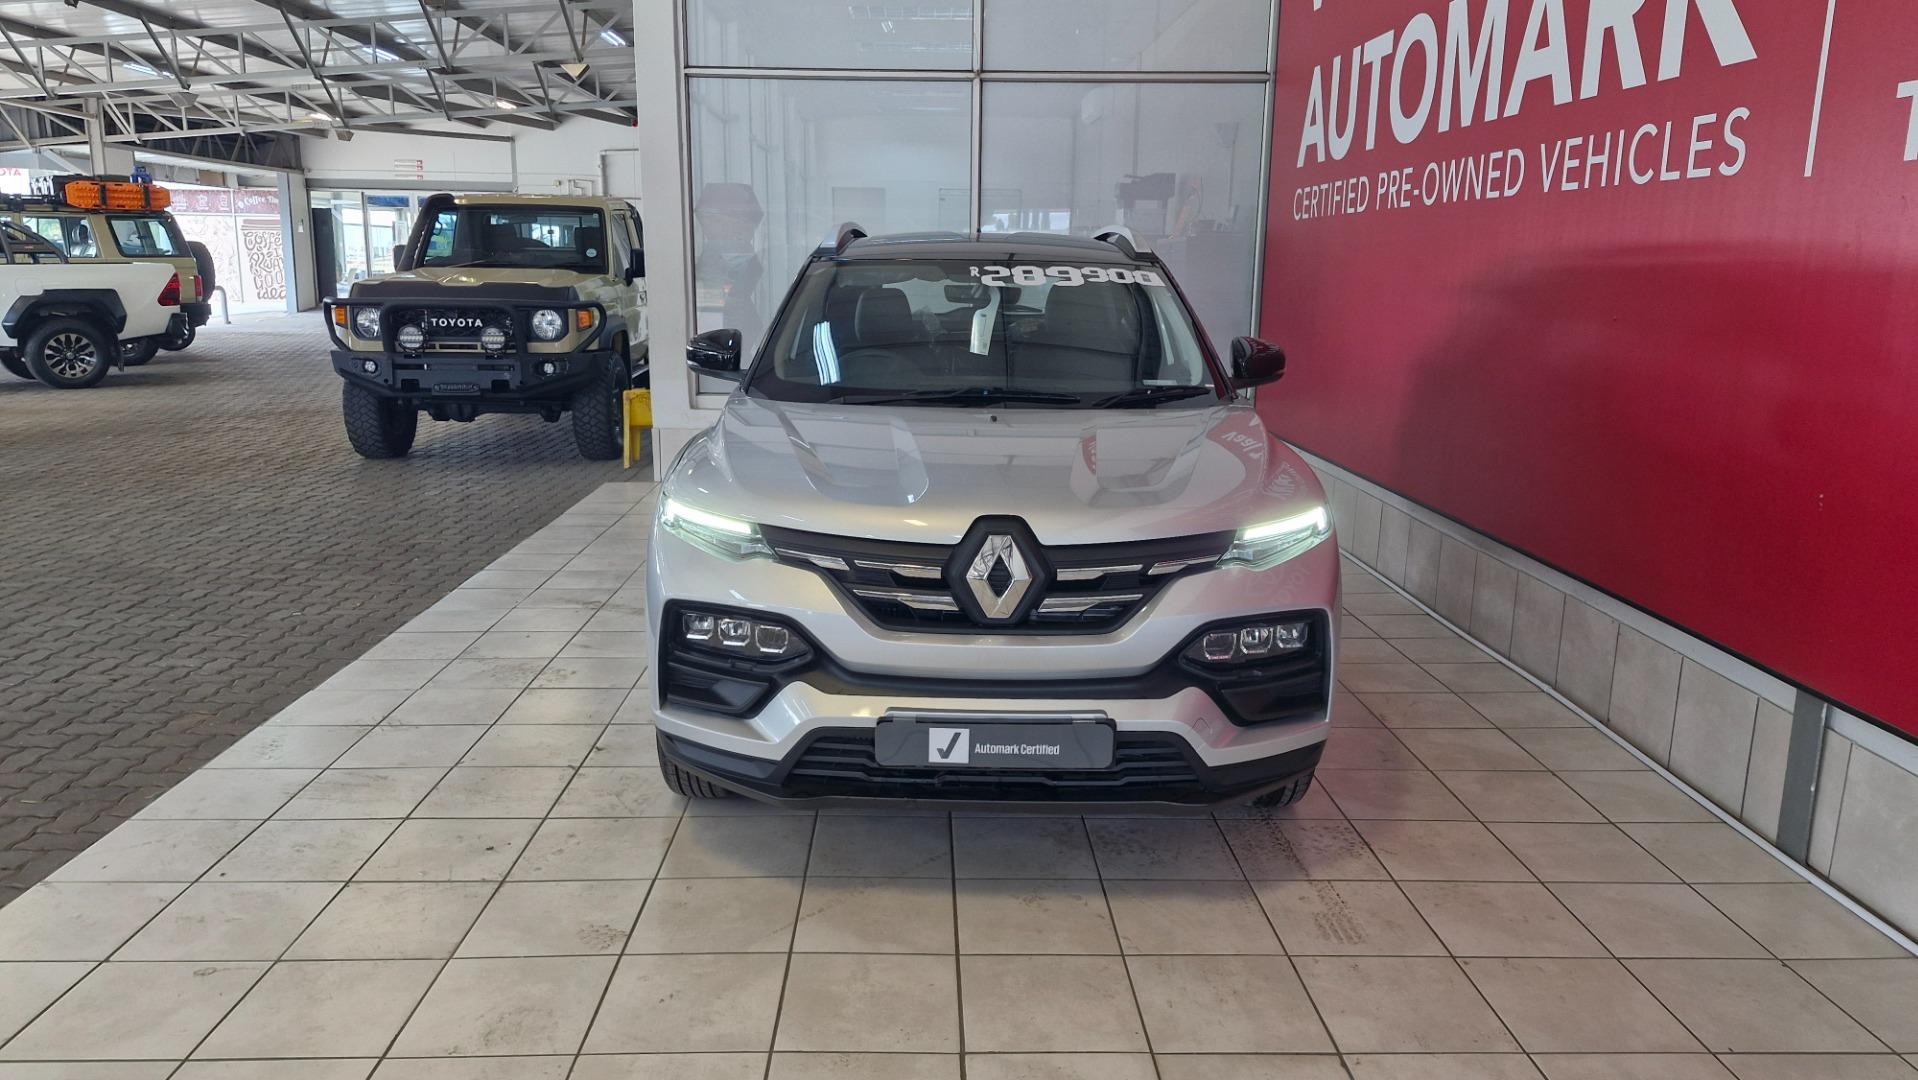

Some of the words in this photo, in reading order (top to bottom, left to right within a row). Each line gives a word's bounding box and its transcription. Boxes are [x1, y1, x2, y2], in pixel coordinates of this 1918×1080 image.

[1294, 175, 1370, 221] CERTIFIED
[1376, 148, 1525, 211] PRE-OWNED
[1540, 107, 1750, 193] VEHICLES
[430, 318, 483, 327] TOYOTA
[974, 742, 1019, 755] Automark
[1020, 742, 1060, 756] Certified
